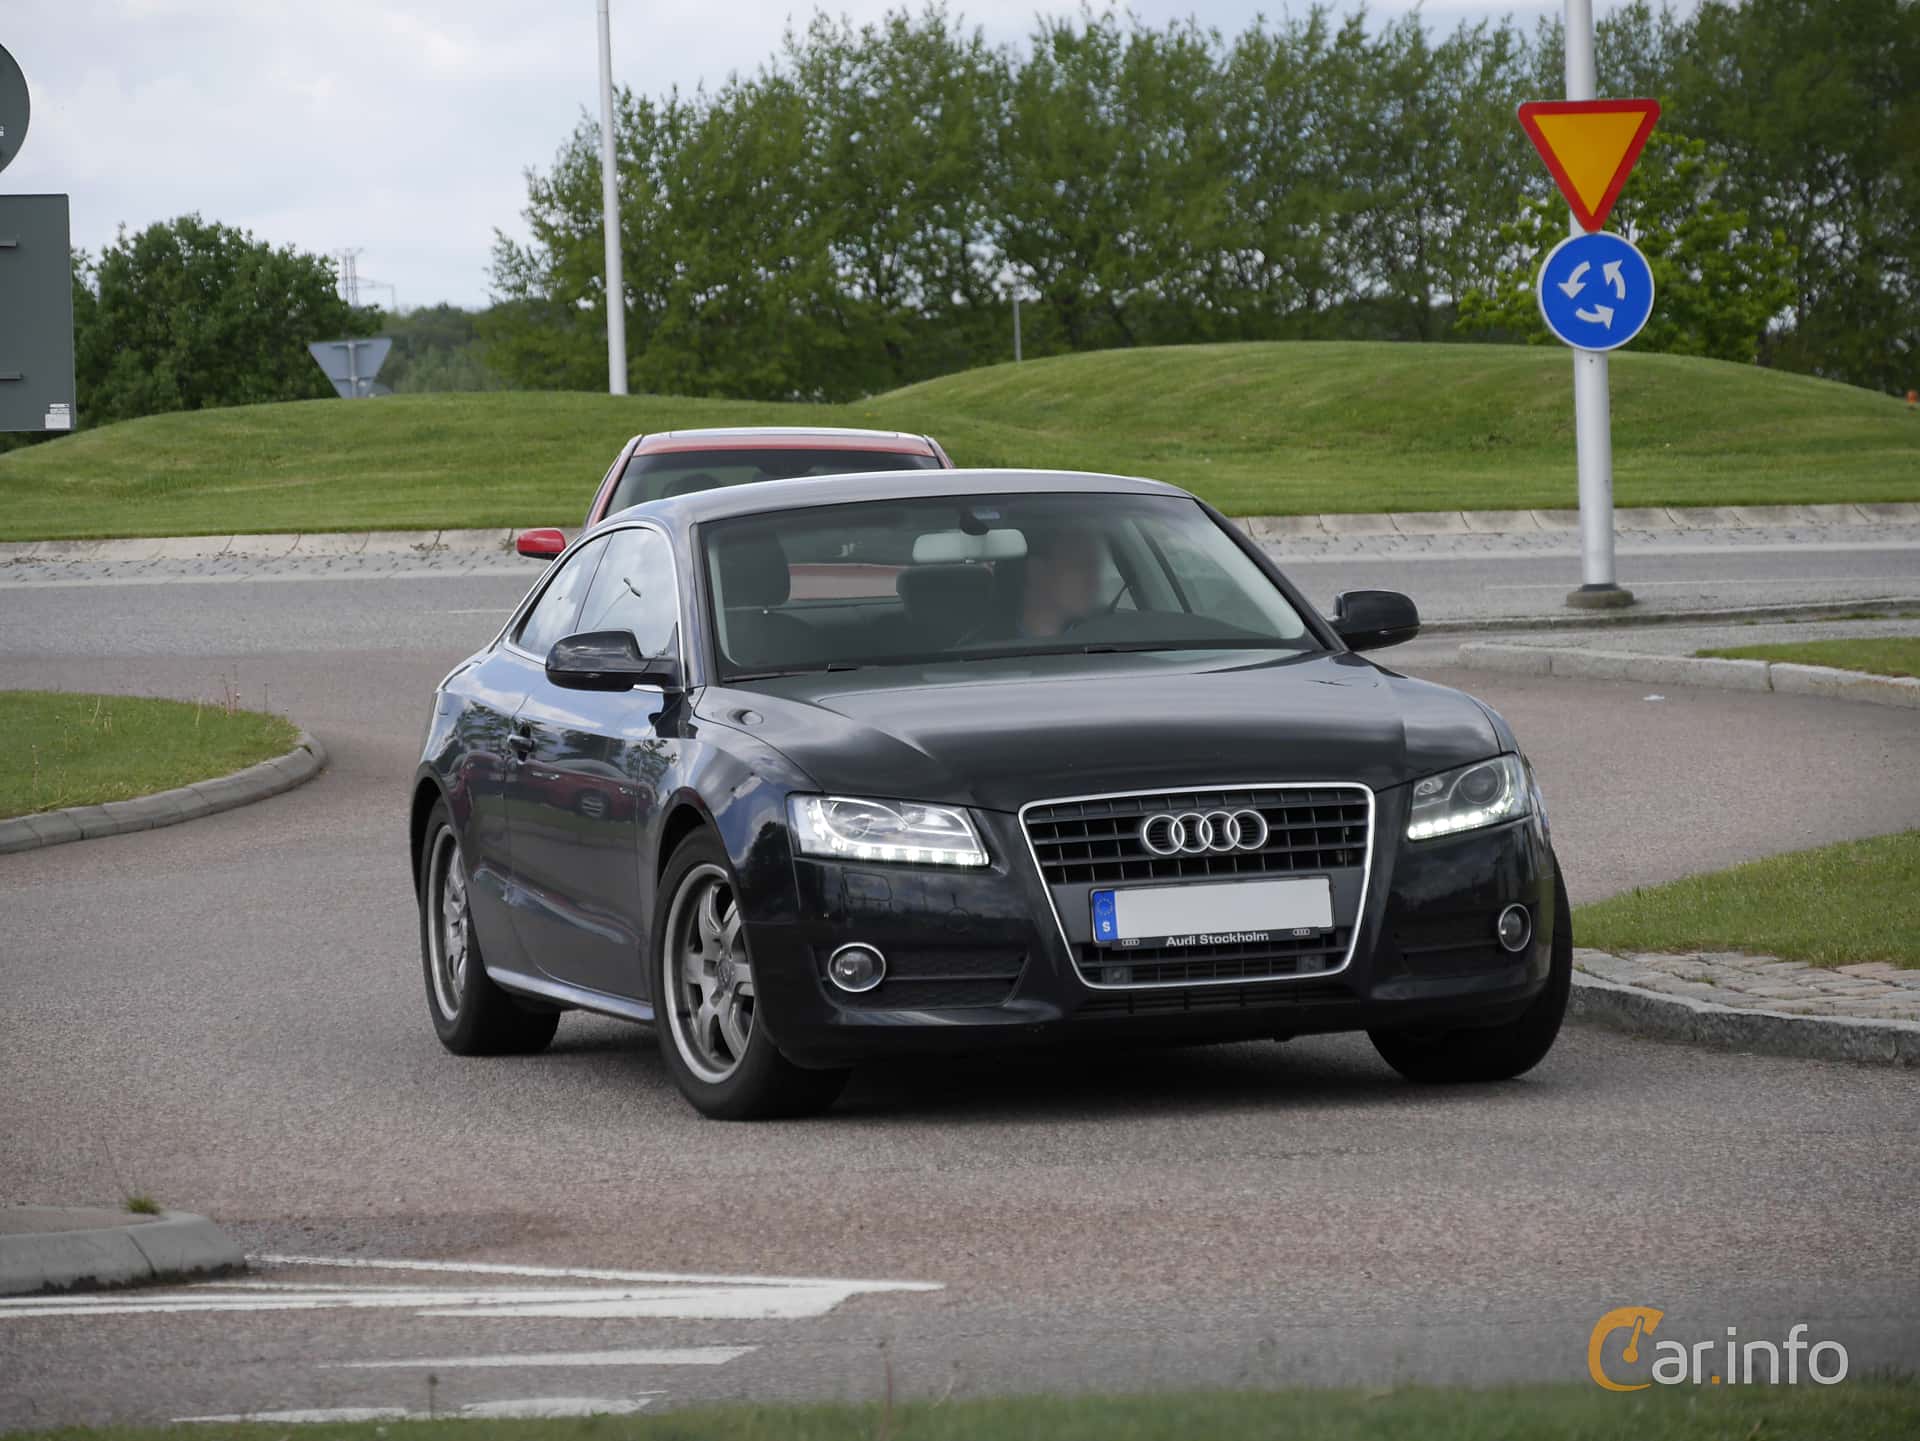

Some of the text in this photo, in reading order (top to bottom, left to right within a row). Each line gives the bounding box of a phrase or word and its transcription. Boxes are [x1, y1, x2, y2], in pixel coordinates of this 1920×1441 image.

[1102, 921, 1111, 933] S
[1165, 931, 1270, 947] Audi Stockholm
